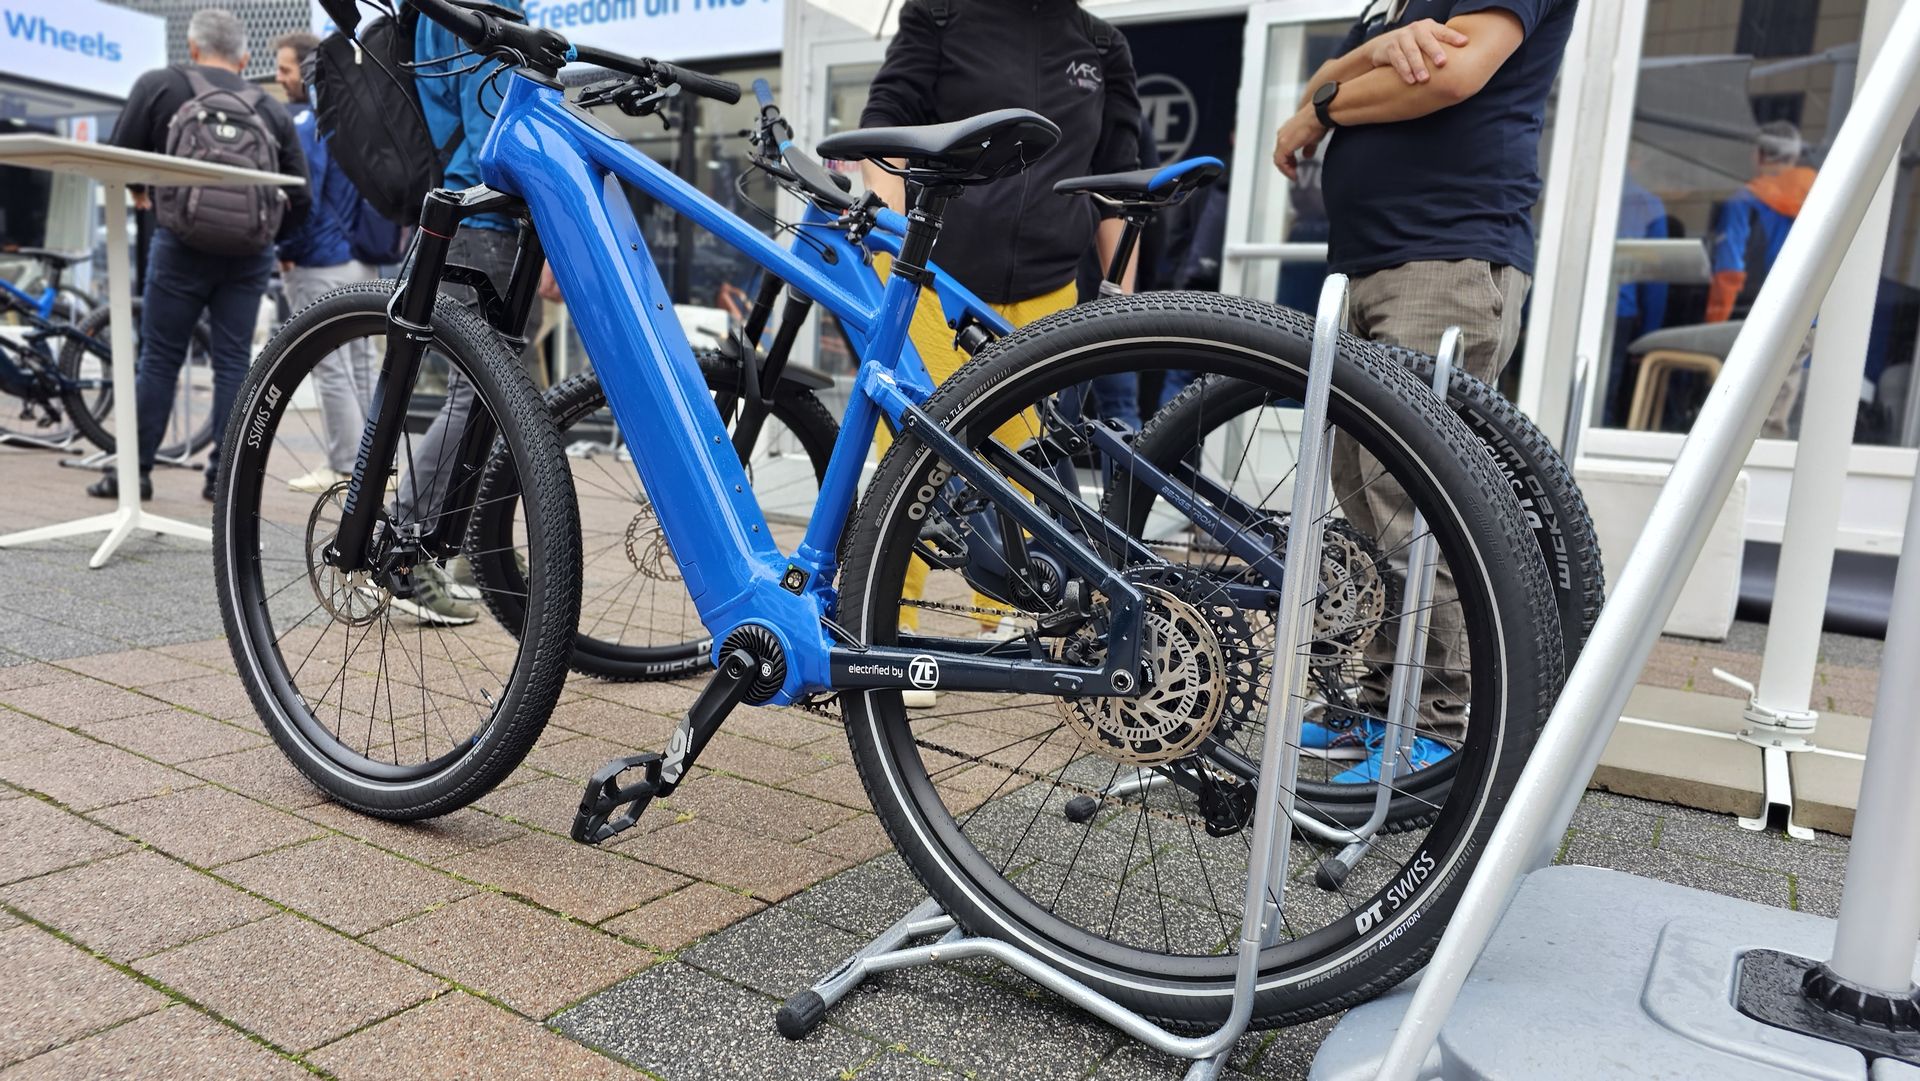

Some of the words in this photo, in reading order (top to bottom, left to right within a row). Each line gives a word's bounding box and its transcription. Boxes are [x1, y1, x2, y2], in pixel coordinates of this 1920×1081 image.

[4, 9, 122, 62] Wheels
[526, 0, 636, 28] Freedom
[265, 383, 282, 410] DT
[247, 406, 271, 449] SWISS
[1468, 409, 1527, 470] WILL
[875, 455, 917, 528] SCHWALBE
[950, 402, 964, 418] TLE
[1525, 474, 1571, 590] WICKED
[848, 663, 890, 676] electrified
[891, 665, 903, 678] by
[909, 657, 939, 687] ZF
[1355, 900, 1384, 936] DT
[1386, 850, 1436, 910] SWISS
[1297, 946, 1379, 991] MARATHON
[1378, 912, 1421, 950] ALMOTION
